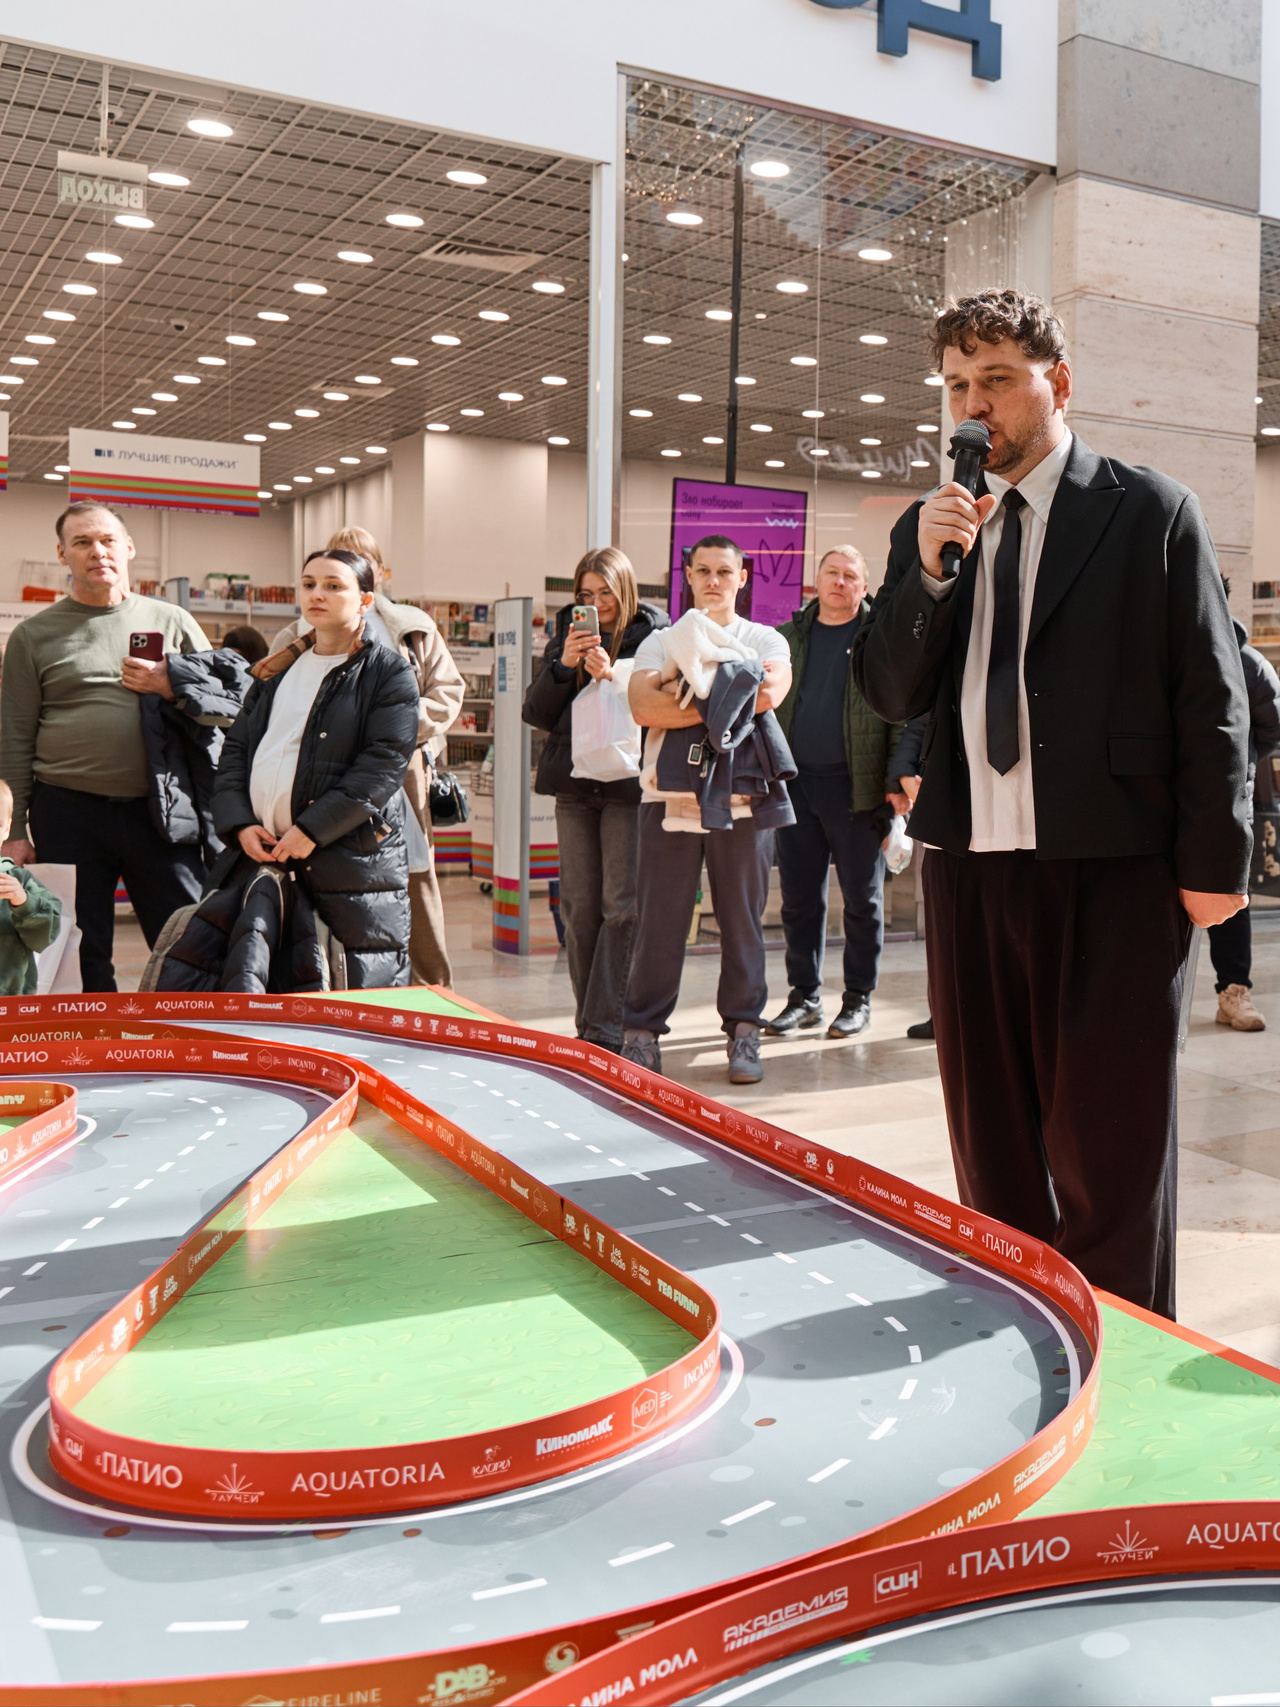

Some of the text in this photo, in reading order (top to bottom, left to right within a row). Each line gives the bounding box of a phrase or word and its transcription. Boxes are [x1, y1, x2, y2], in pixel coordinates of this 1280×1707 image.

[118, 450, 236, 469] ЛУЧШИЕ ПРОДАЖИ
[58, 1002, 107, 1013] ПАТИО
[155, 1000, 214, 1012] AQUATORIA
[323, 1005, 353, 1017] INCANTO
[106, 1049, 174, 1062] AQUATORIA
[288, 1057, 316, 1071] INCANTO
[658, 1089, 685, 1109] AQUATORIA
[745, 1124, 769, 1143] INCANTO
[470, 1149, 496, 1176] AQUATORIA
[866, 1181, 908, 1208] КАЛИНА МОЛЛ
[913, 1200, 952, 1225] АКАДЕМИЯ
[610, 1252, 626, 1271] Studio
[985, 1232, 1023, 1264] ПАТИО
[657, 1278, 674, 1300] TEA
[1054, 1271, 1085, 1312] AQUATORIA
[683, 1348, 717, 1390] INCANTO
[634, 1398, 656, 1420] MED
[536, 1413, 613, 1456] КИНОМАКС
[102, 1451, 183, 1489] ПАТИО
[1013, 1434, 1067, 1488] АКАДЕМИЯ
[291, 1461, 446, 1497] AQUATORIA
[966, 1492, 1001, 1525] МОЛЛ
[961, 1536, 1071, 1579] ПАТИО
[723, 1586, 849, 1643] АКАДЕМИЯ
[435, 1663, 489, 1698] DAB
[568, 1647, 698, 1707] ЛИНА МОЛЛ
